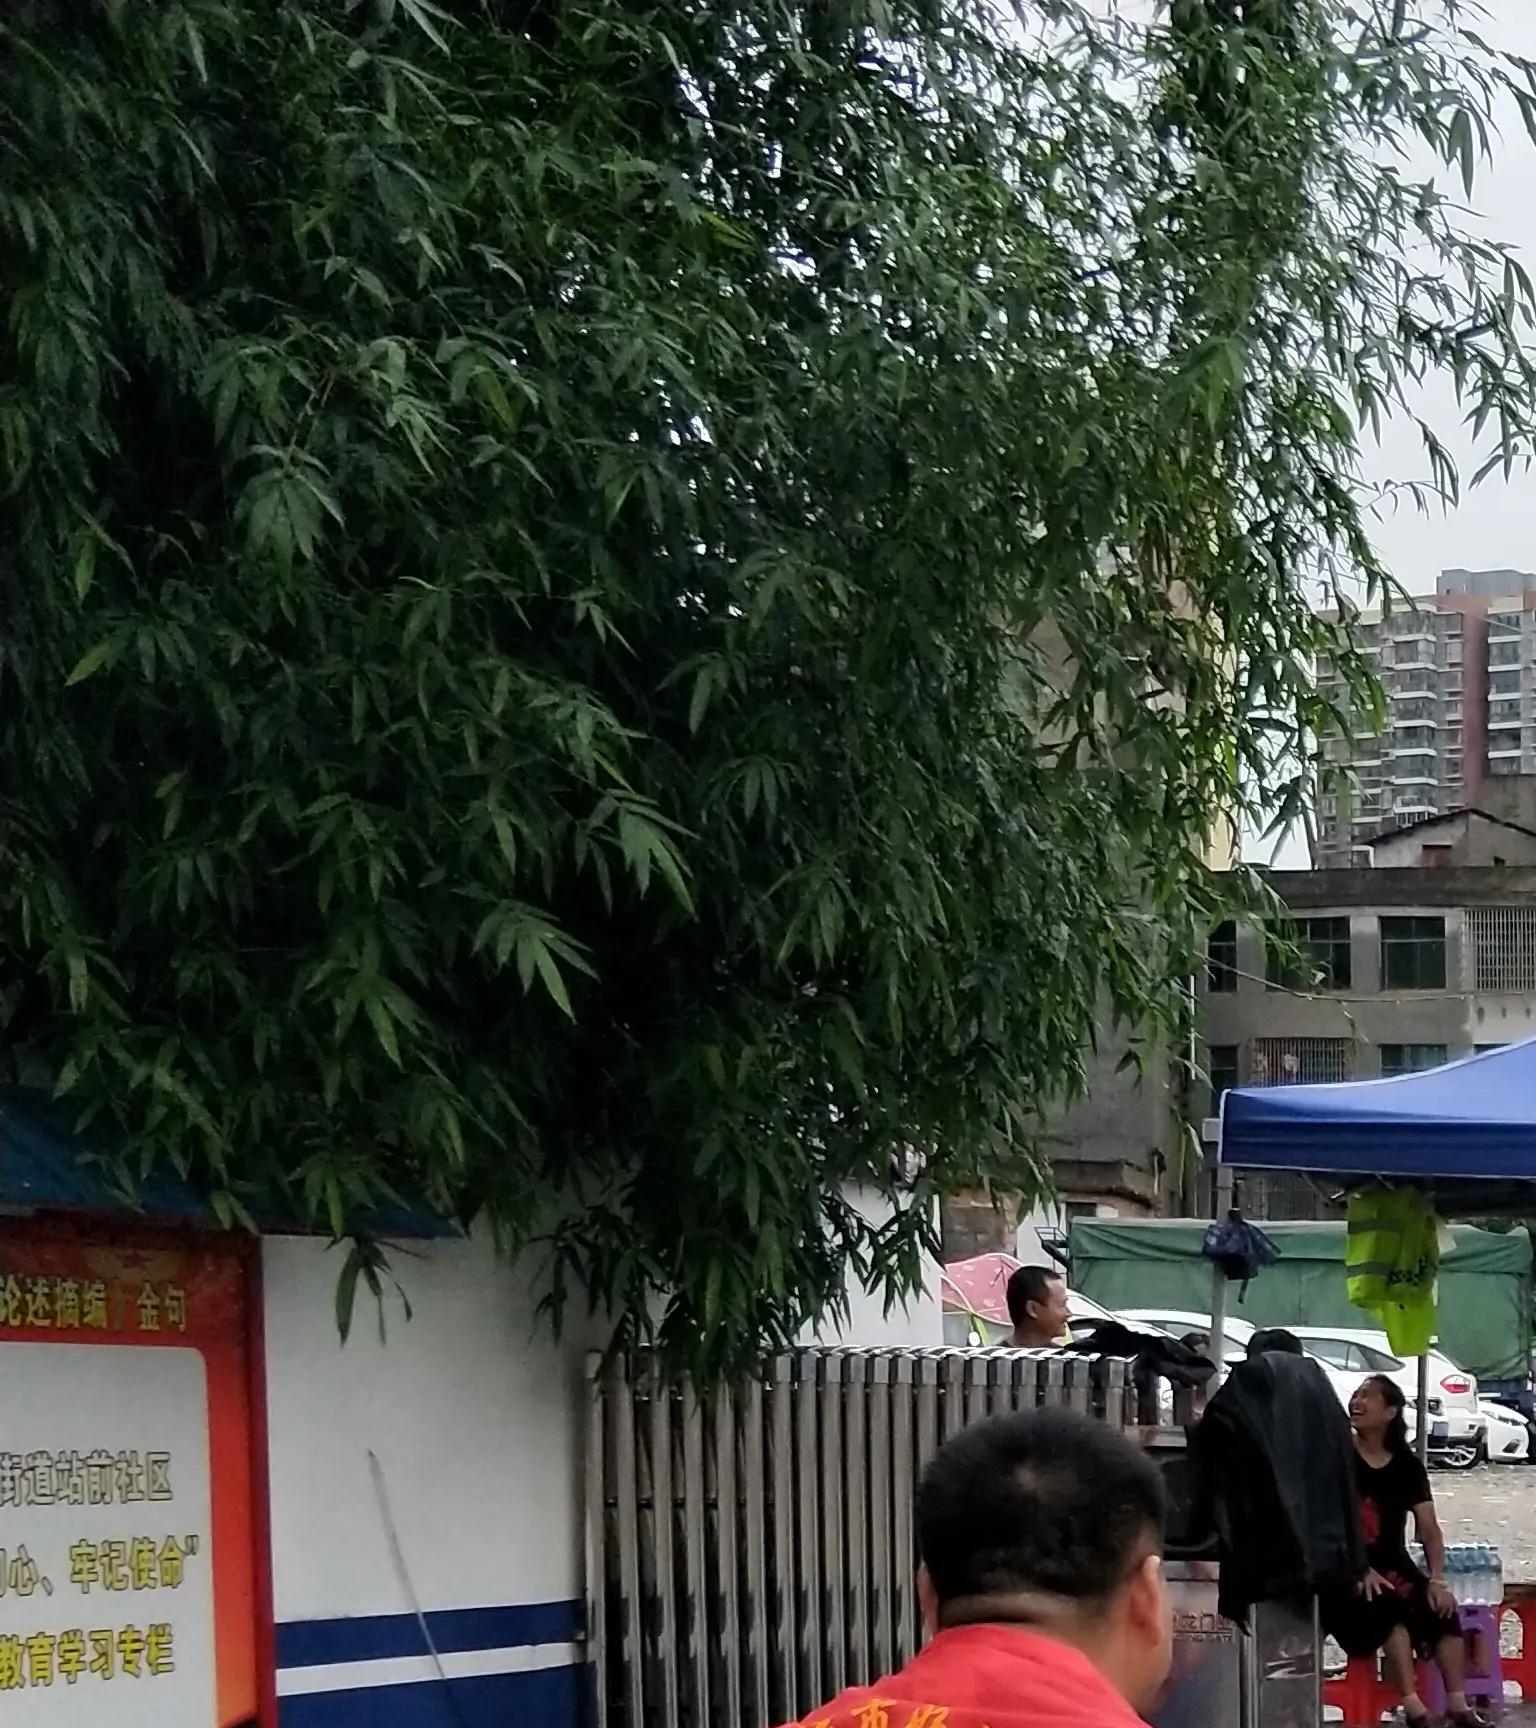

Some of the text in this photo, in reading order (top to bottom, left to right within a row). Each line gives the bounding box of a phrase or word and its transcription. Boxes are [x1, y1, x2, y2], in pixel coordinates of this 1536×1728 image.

[0, 1534, 200, 1597] 心、牢记使命”
